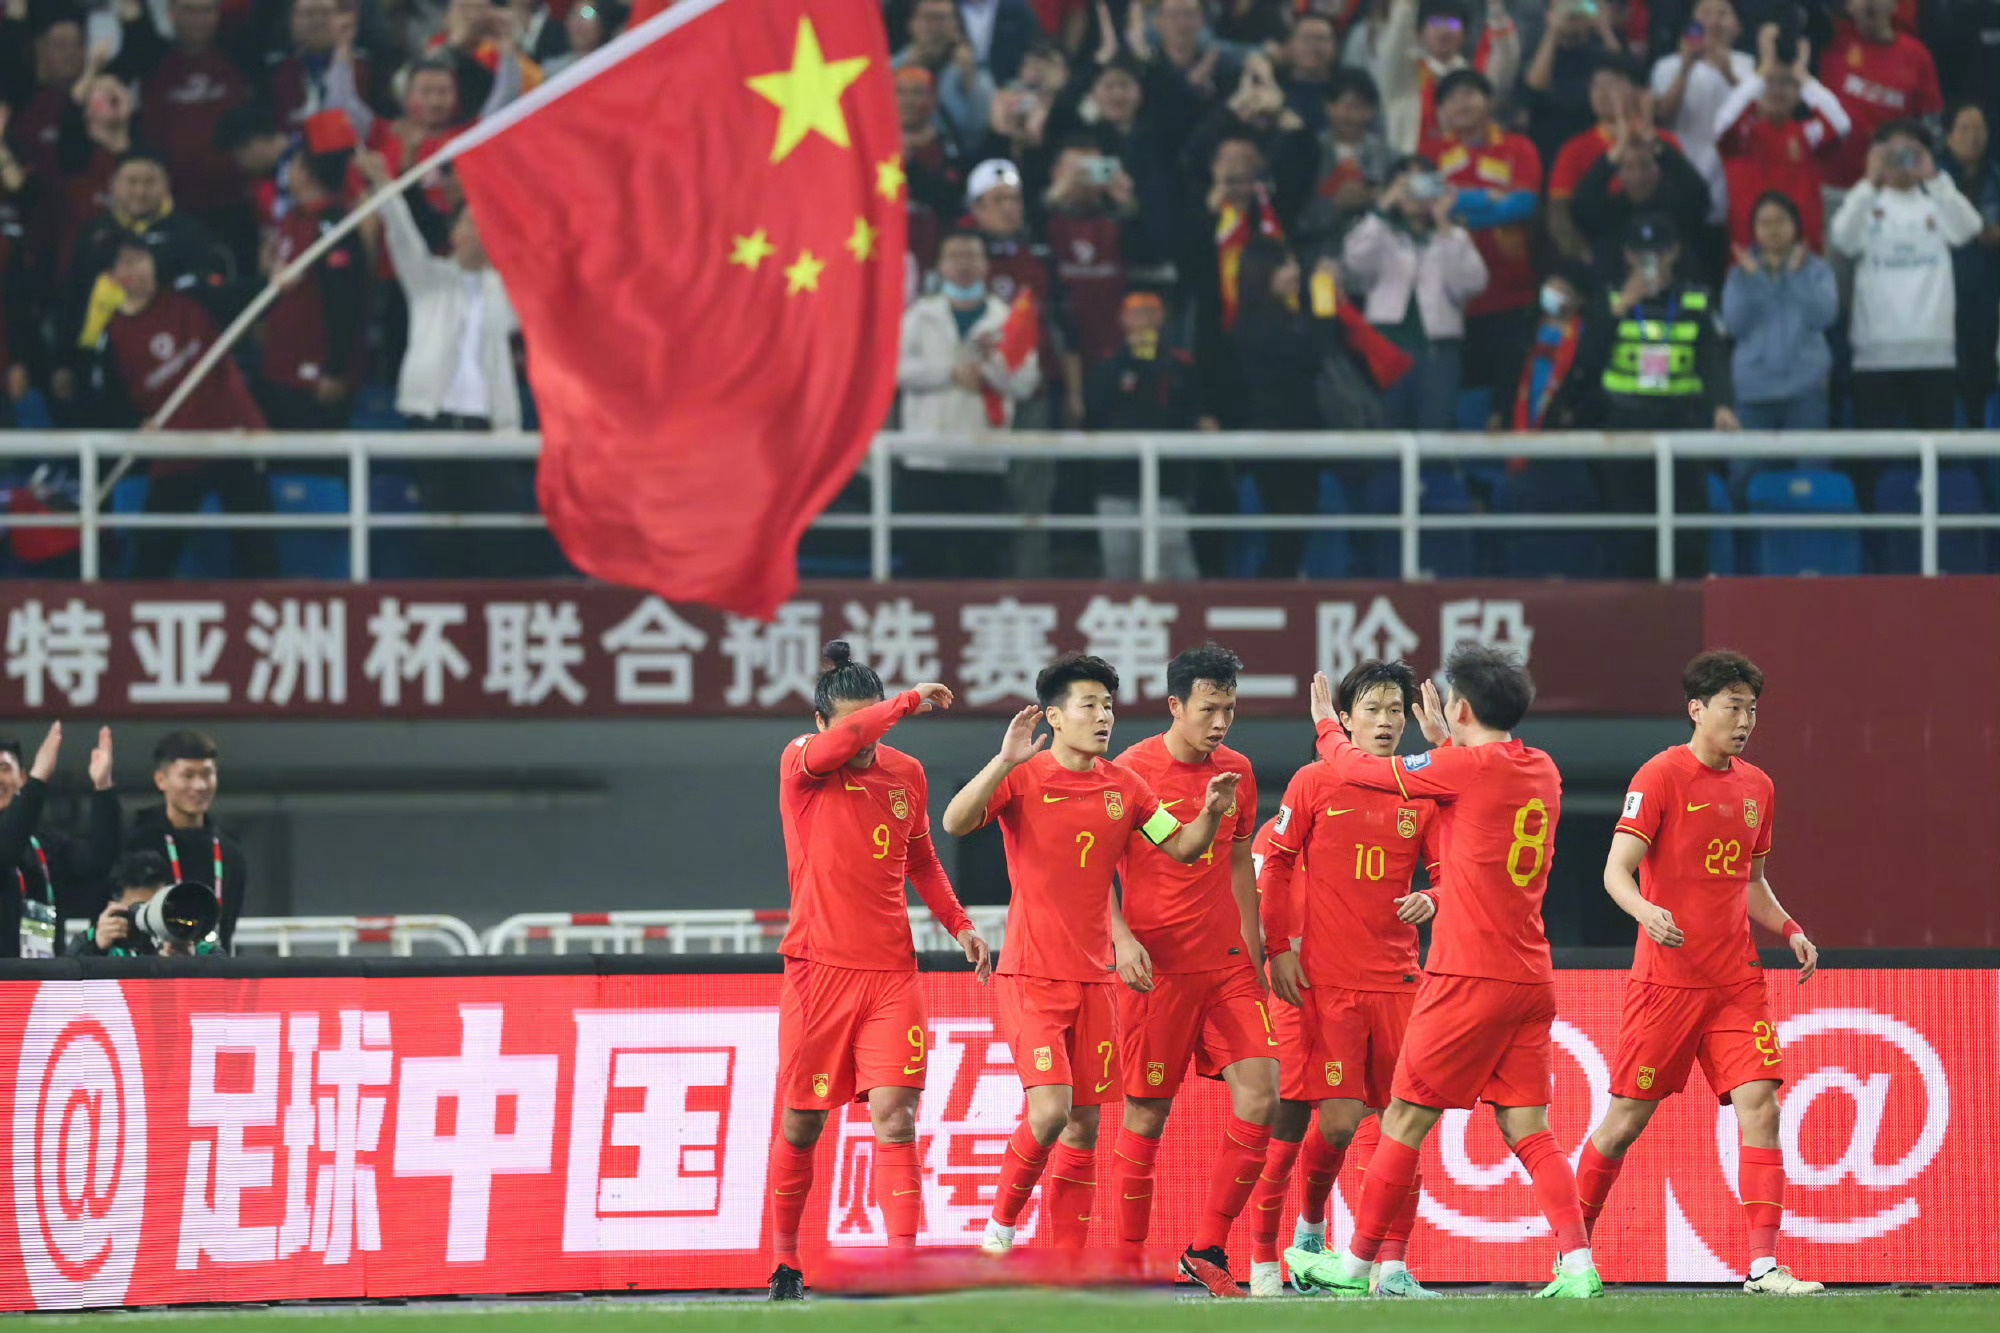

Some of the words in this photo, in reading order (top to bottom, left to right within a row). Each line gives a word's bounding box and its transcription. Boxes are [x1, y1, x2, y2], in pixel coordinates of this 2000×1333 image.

[872, 823, 890, 860] 9
[1075, 831, 1095, 868] 7
[1507, 798, 1549, 887] 8
[1705, 838, 1741, 876] 22
[1355, 843, 1385, 881] 10
[907, 1025, 925, 1062] 9
[1097, 1041, 1113, 1078] 7
